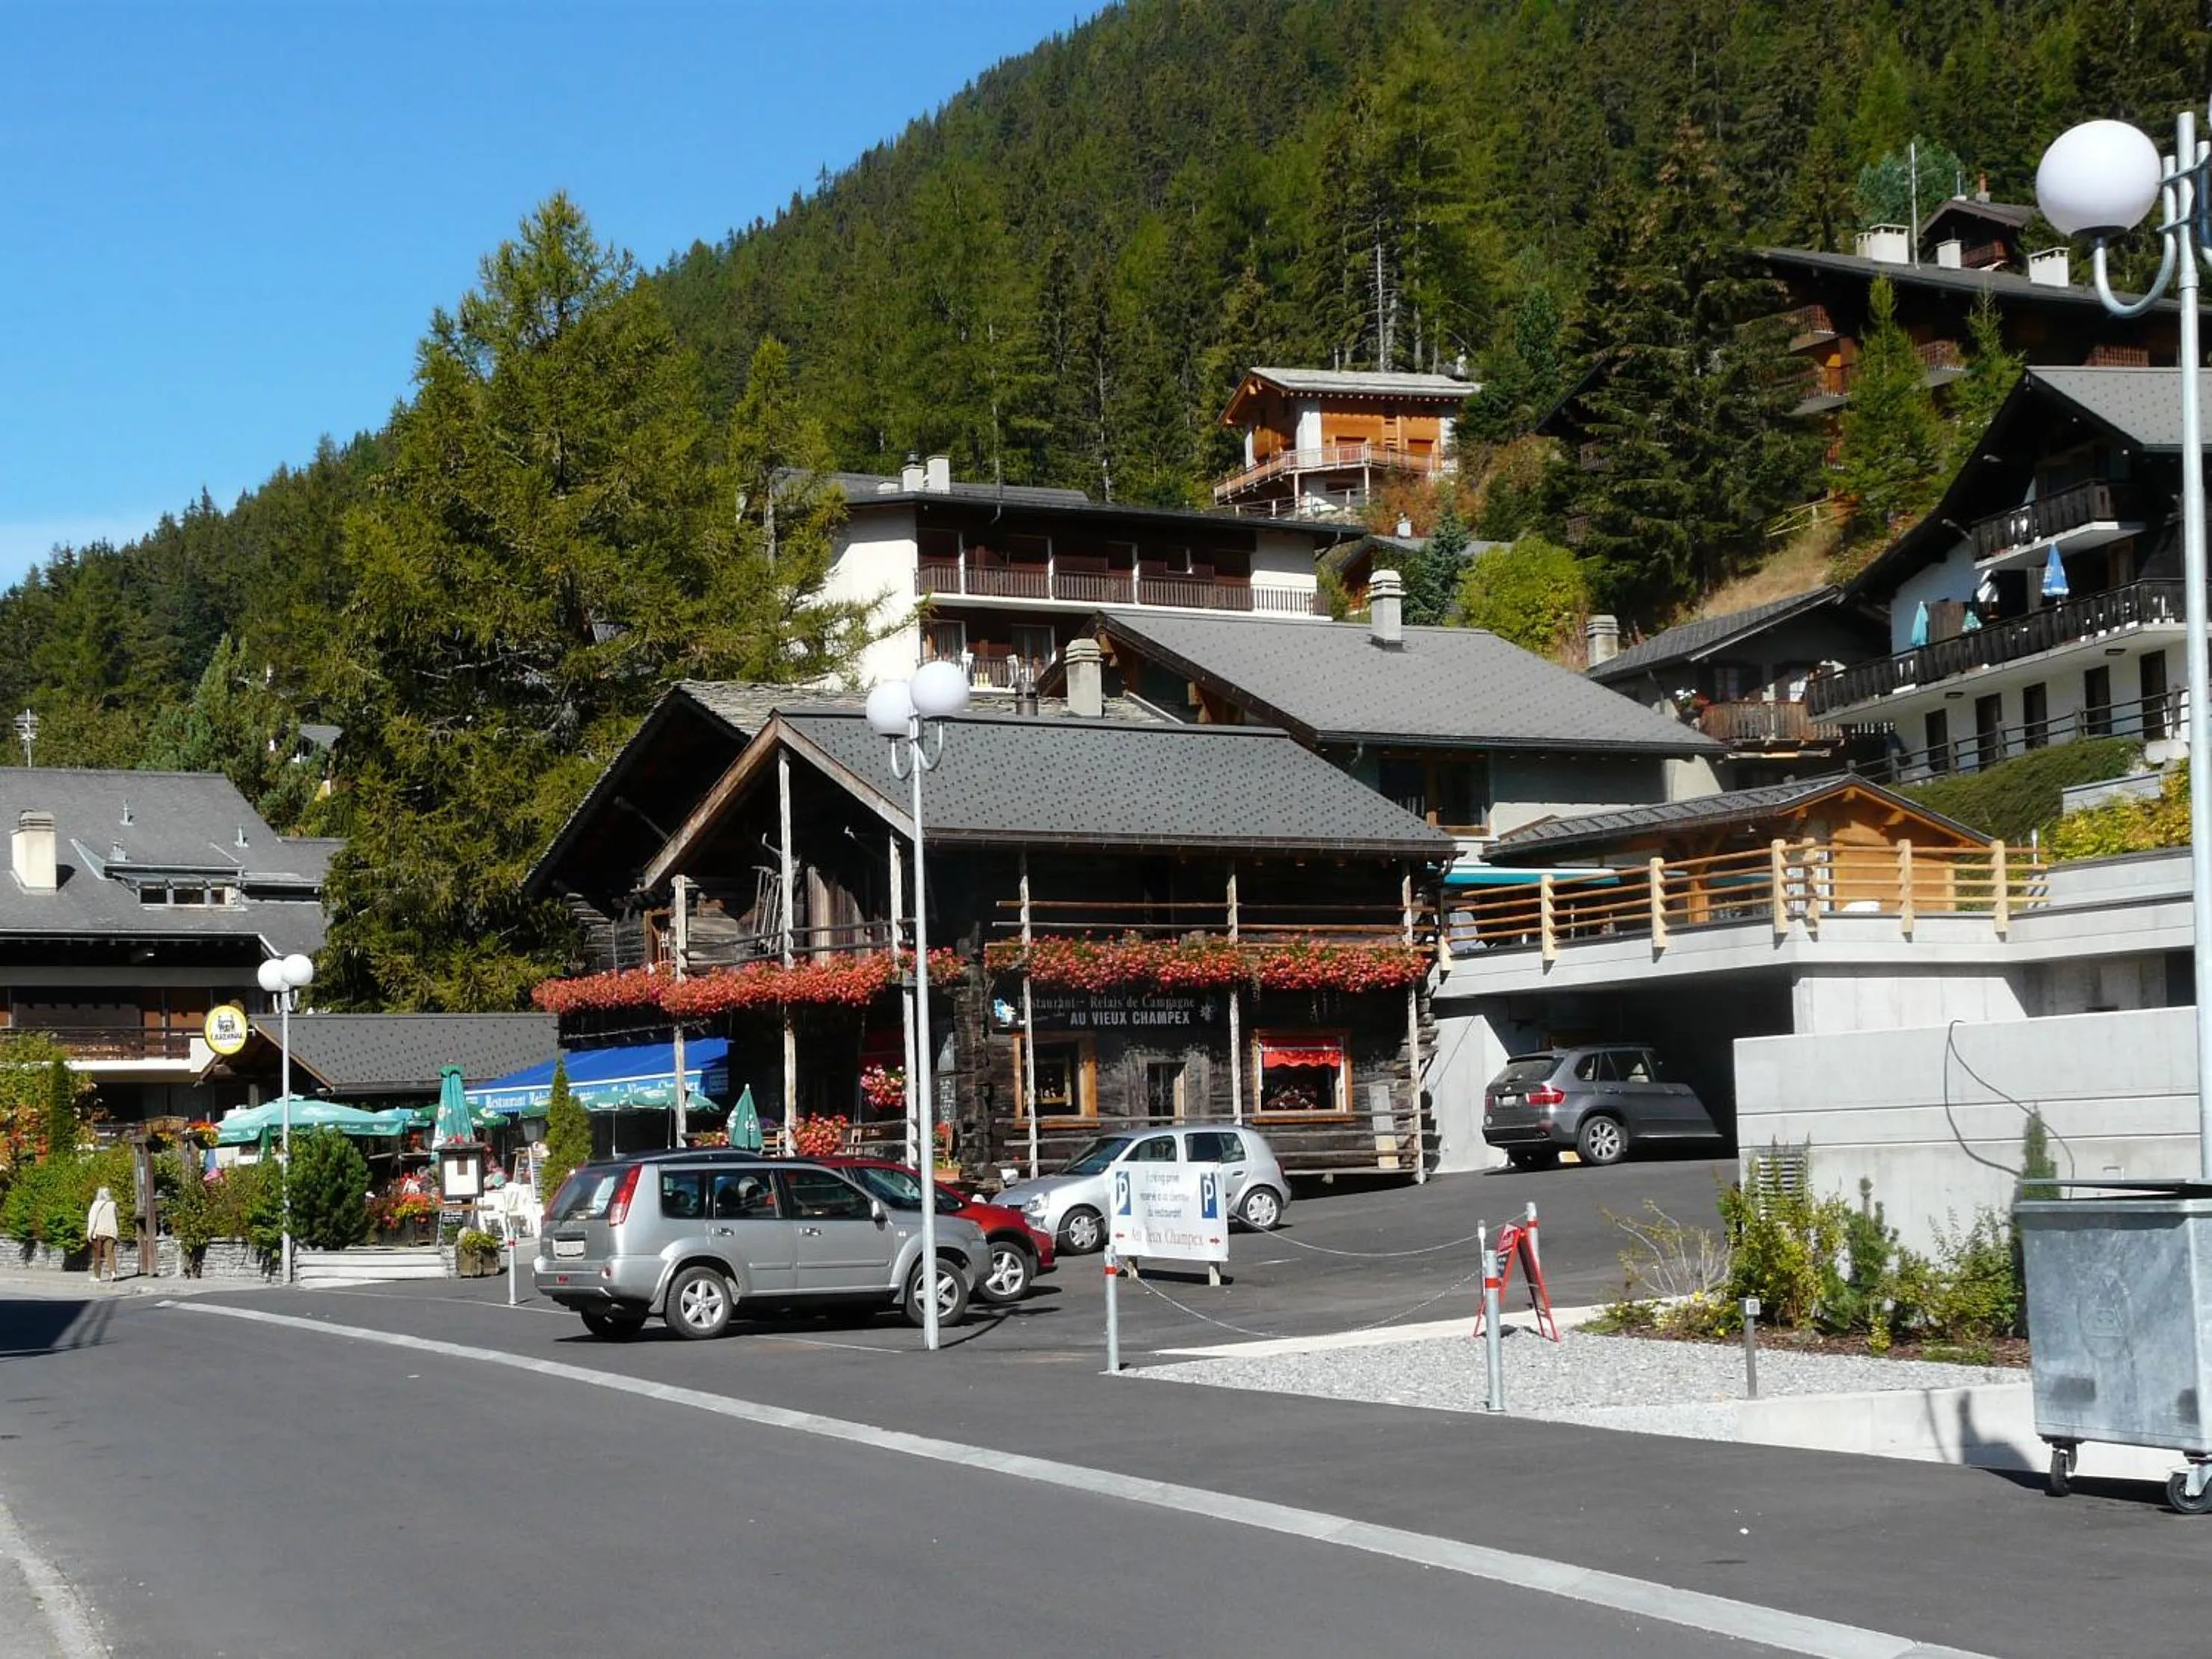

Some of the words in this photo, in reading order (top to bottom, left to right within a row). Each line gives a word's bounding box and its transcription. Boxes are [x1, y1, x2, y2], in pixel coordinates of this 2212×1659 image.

[1090, 996, 1121, 1009] Relais
[1125, 996, 1139, 1009] de
[1142, 995, 1195, 1011] Campagne
[1070, 1011, 1085, 1025] AU
[1092, 1011, 1127, 1025] VIEUX
[1132, 1010, 1190, 1025] CHAMPEX
[1165, 1228, 1204, 1250] Champex
